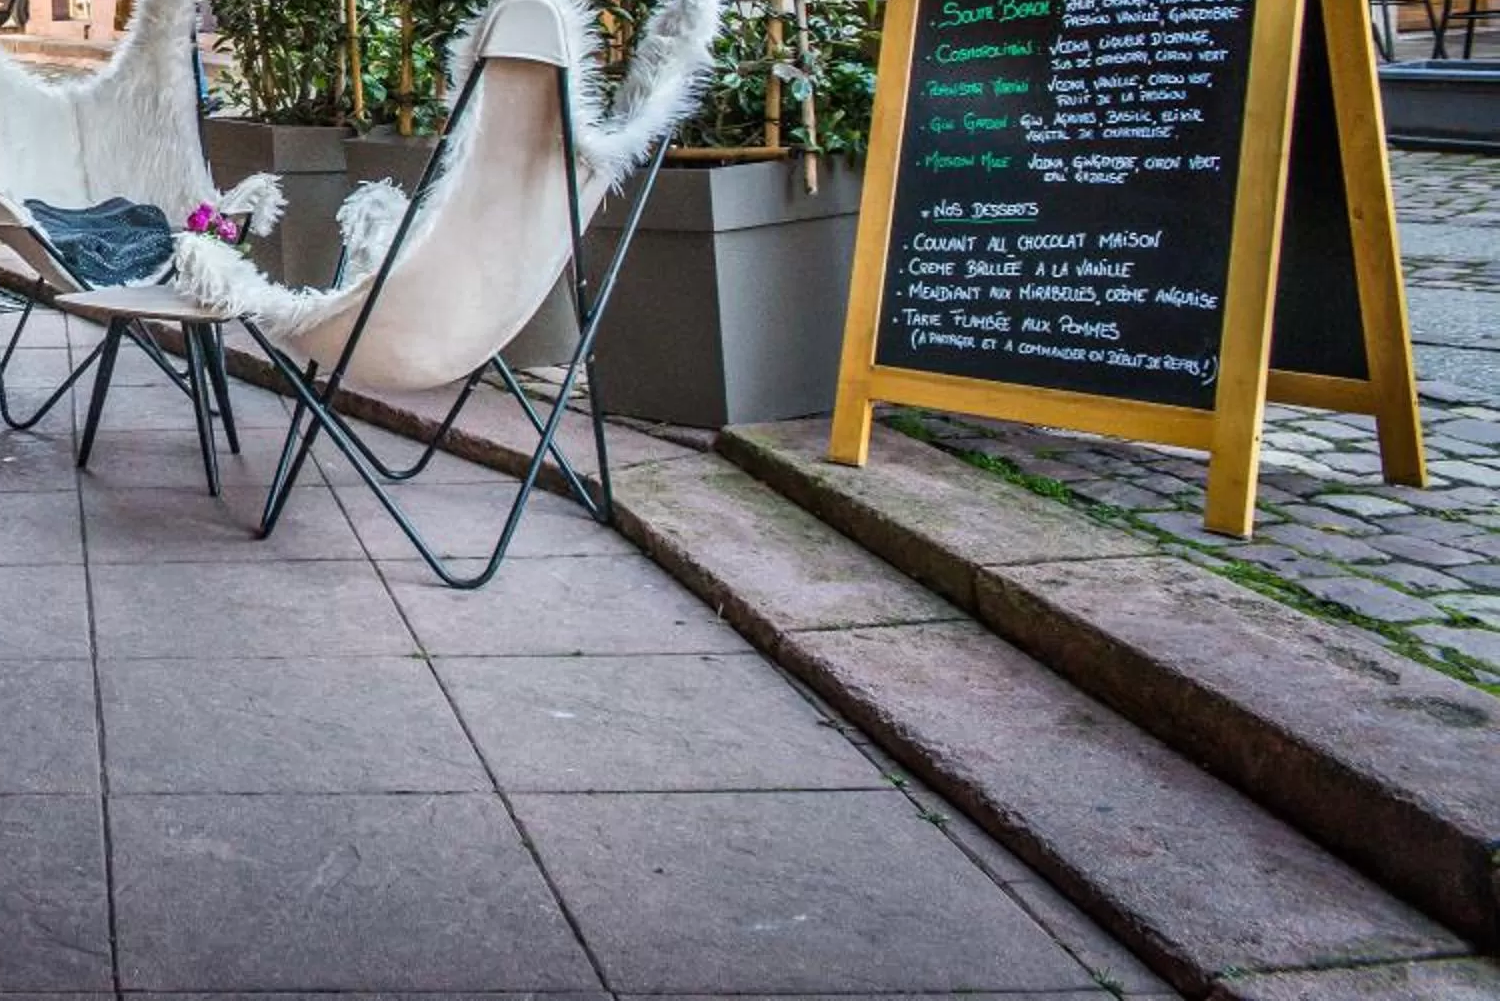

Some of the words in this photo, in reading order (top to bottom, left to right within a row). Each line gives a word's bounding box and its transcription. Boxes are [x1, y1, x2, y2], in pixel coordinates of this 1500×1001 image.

[932, 198, 963, 218] NOS
[970, 201, 1040, 219] DESSERTS
[1017, 232, 1088, 251] CHOCOLAT
[1051, 262, 1070, 279] LA
[1058, 315, 1121, 341] POMMES
